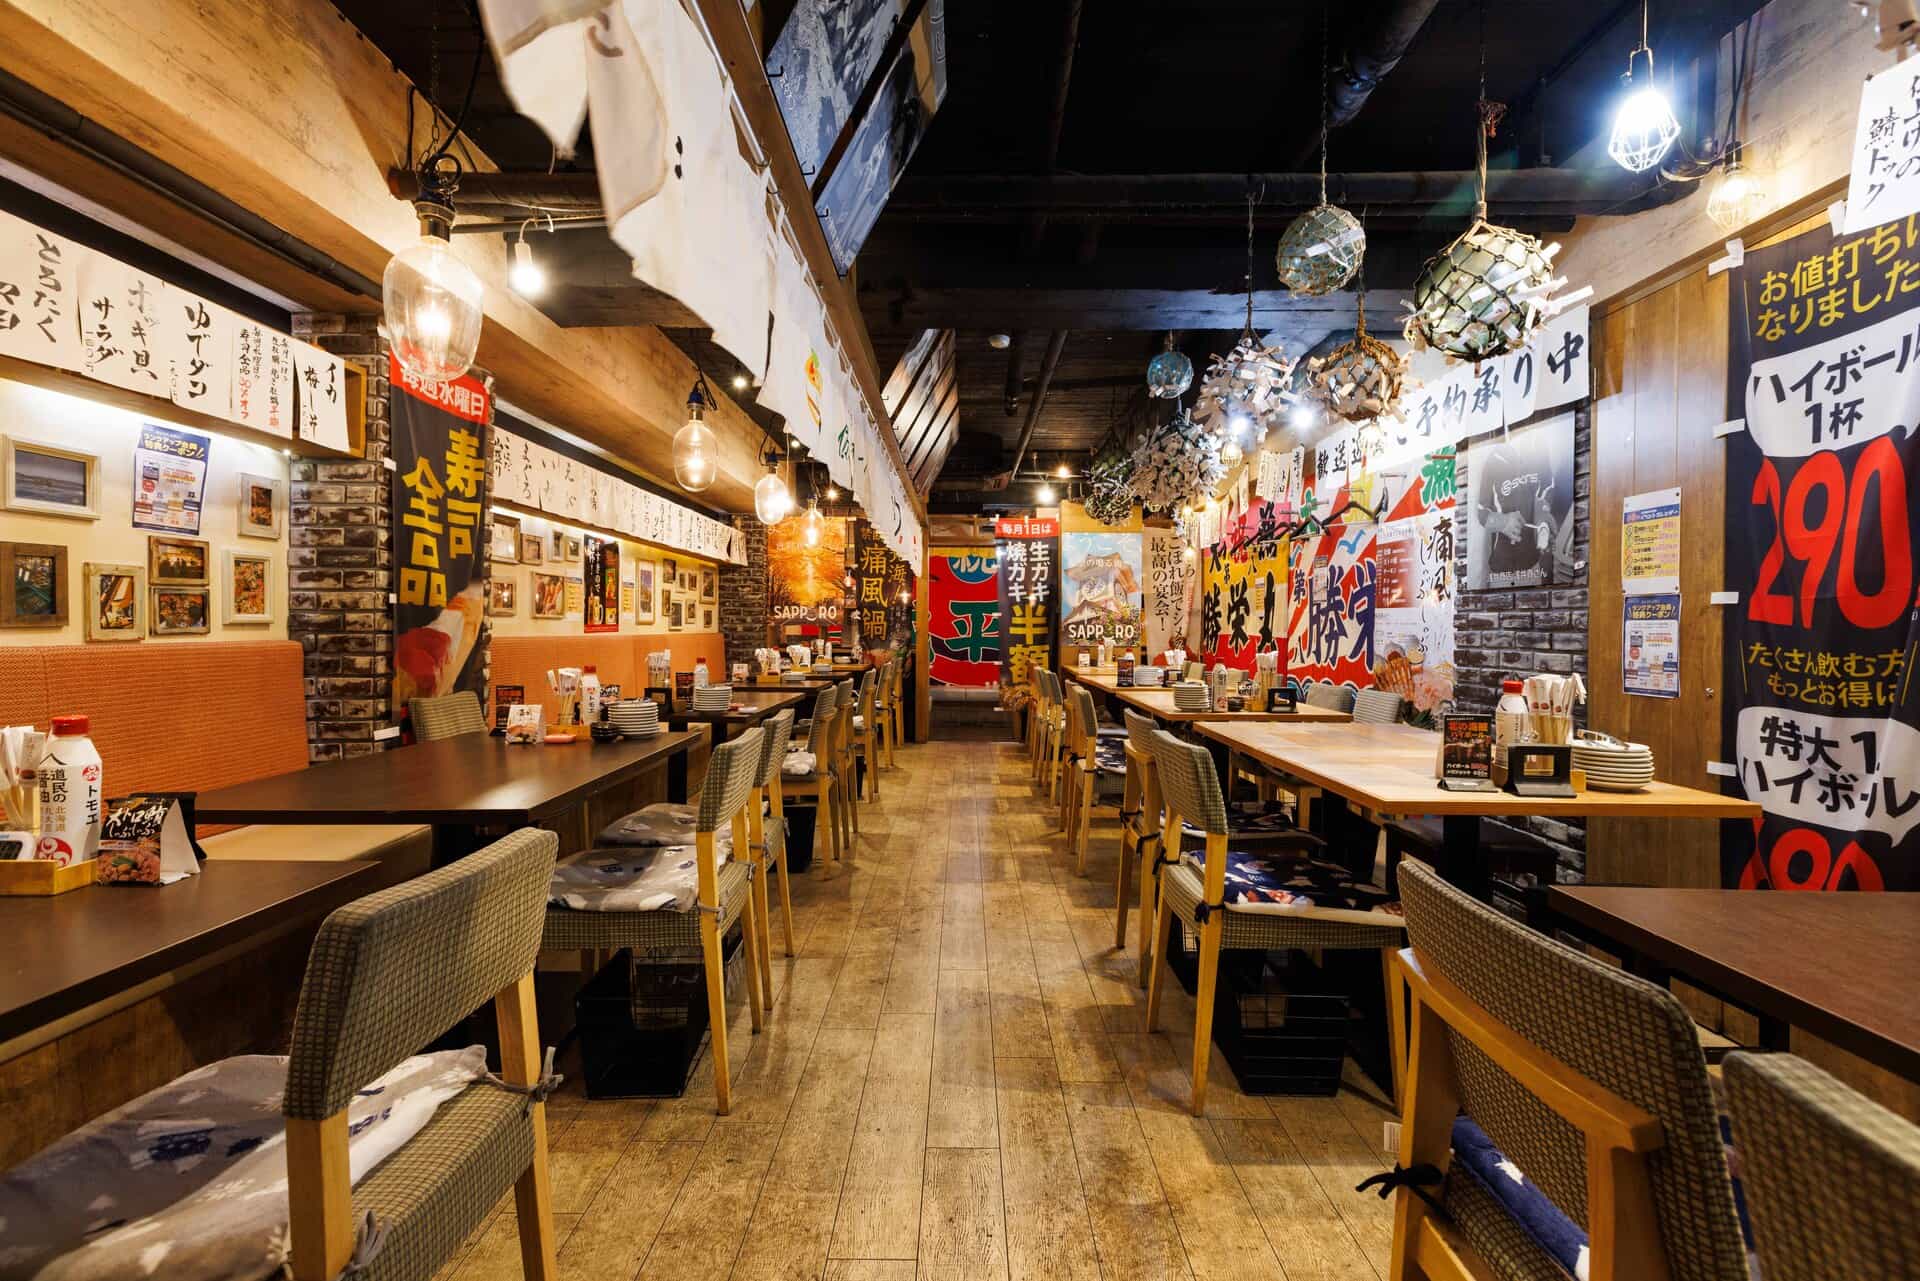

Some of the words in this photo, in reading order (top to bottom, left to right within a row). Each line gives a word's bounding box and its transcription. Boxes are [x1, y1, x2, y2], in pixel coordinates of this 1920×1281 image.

[33, 233, 62, 343] とろたく
[1756, 257, 1920, 342] なりました
[92, 296, 124, 364] サラダ
[185, 301, 214, 399] ゆでダコ
[325, 362, 337, 405] イカ
[1804, 397, 1864, 445] 1杯
[445, 428, 486, 561] 寿司
[402, 456, 448, 608] 全品
[1002, 523, 1051, 535] 毎月1日は
[1427, 516, 1453, 601] 痛風
[1748, 435, 1913, 630] 290
[861, 543, 888, 641] 痛風鍋
[1006, 541, 1028, 602] 焼ガキ
[1029, 541, 1050, 602] 生ガキ
[1008, 604, 1050, 683] 半額
[1750, 642, 1906, 679] たくさん飲む方
[1767, 672, 1898, 708] もっとお得に
[51, 769, 68, 803] 道民の
[86, 785, 99, 825] トモエ
